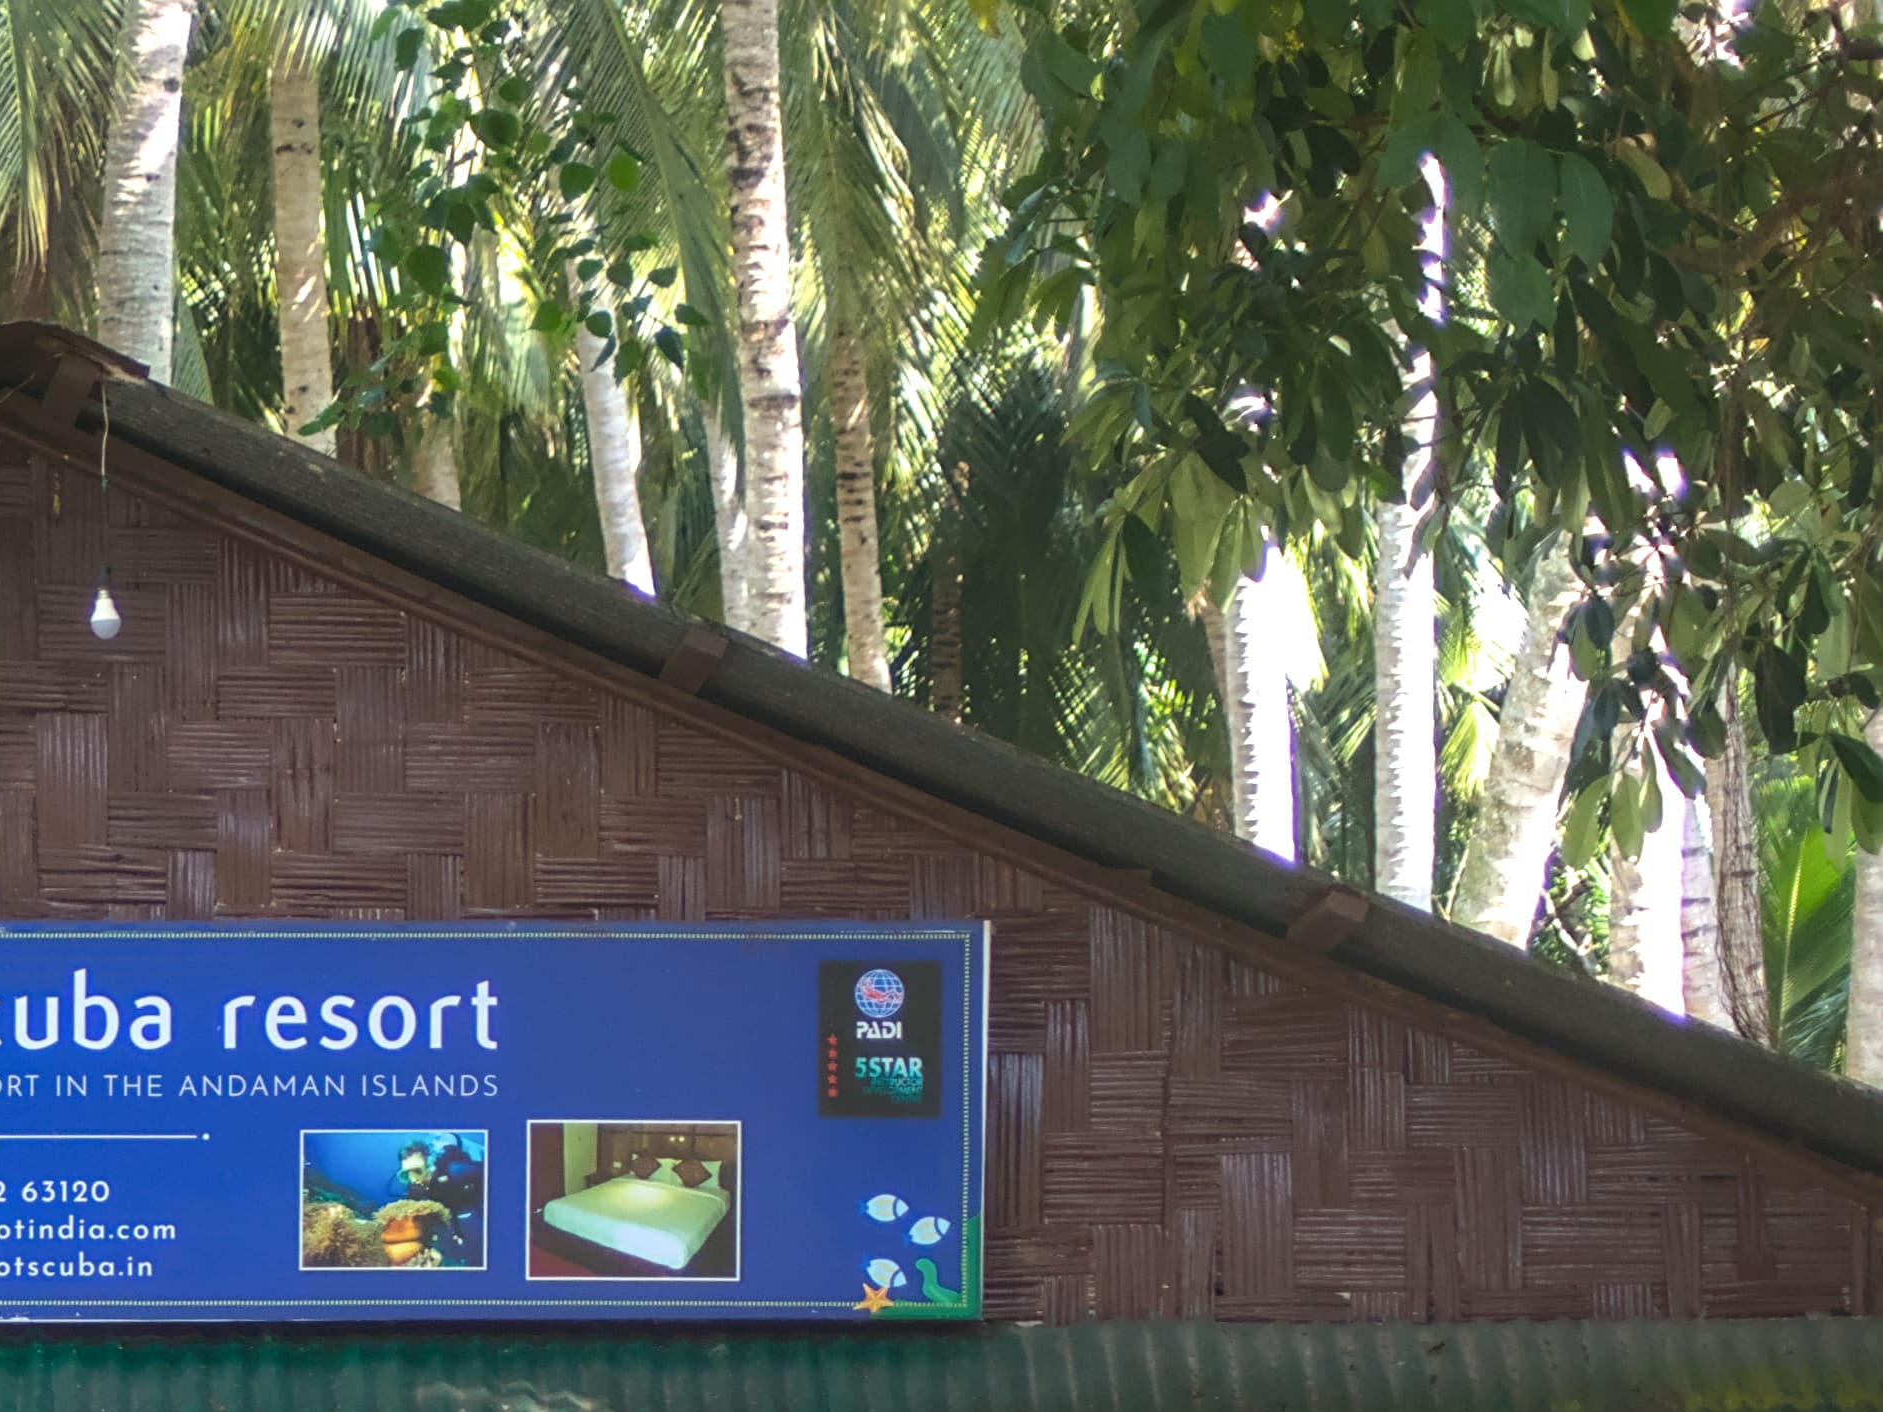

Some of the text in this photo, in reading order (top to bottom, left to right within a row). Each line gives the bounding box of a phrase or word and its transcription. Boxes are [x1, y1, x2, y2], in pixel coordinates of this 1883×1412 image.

[223, 980, 499, 1050] resort
[855, 1020, 902, 1039] PADI
[56, 1075, 88, 1097] IN
[104, 1074, 163, 1097] THE
[178, 1074, 345, 1097] ANDAMAN
[362, 1074, 499, 1097] ISLANDS
[21, 1181, 110, 1203] 63120
